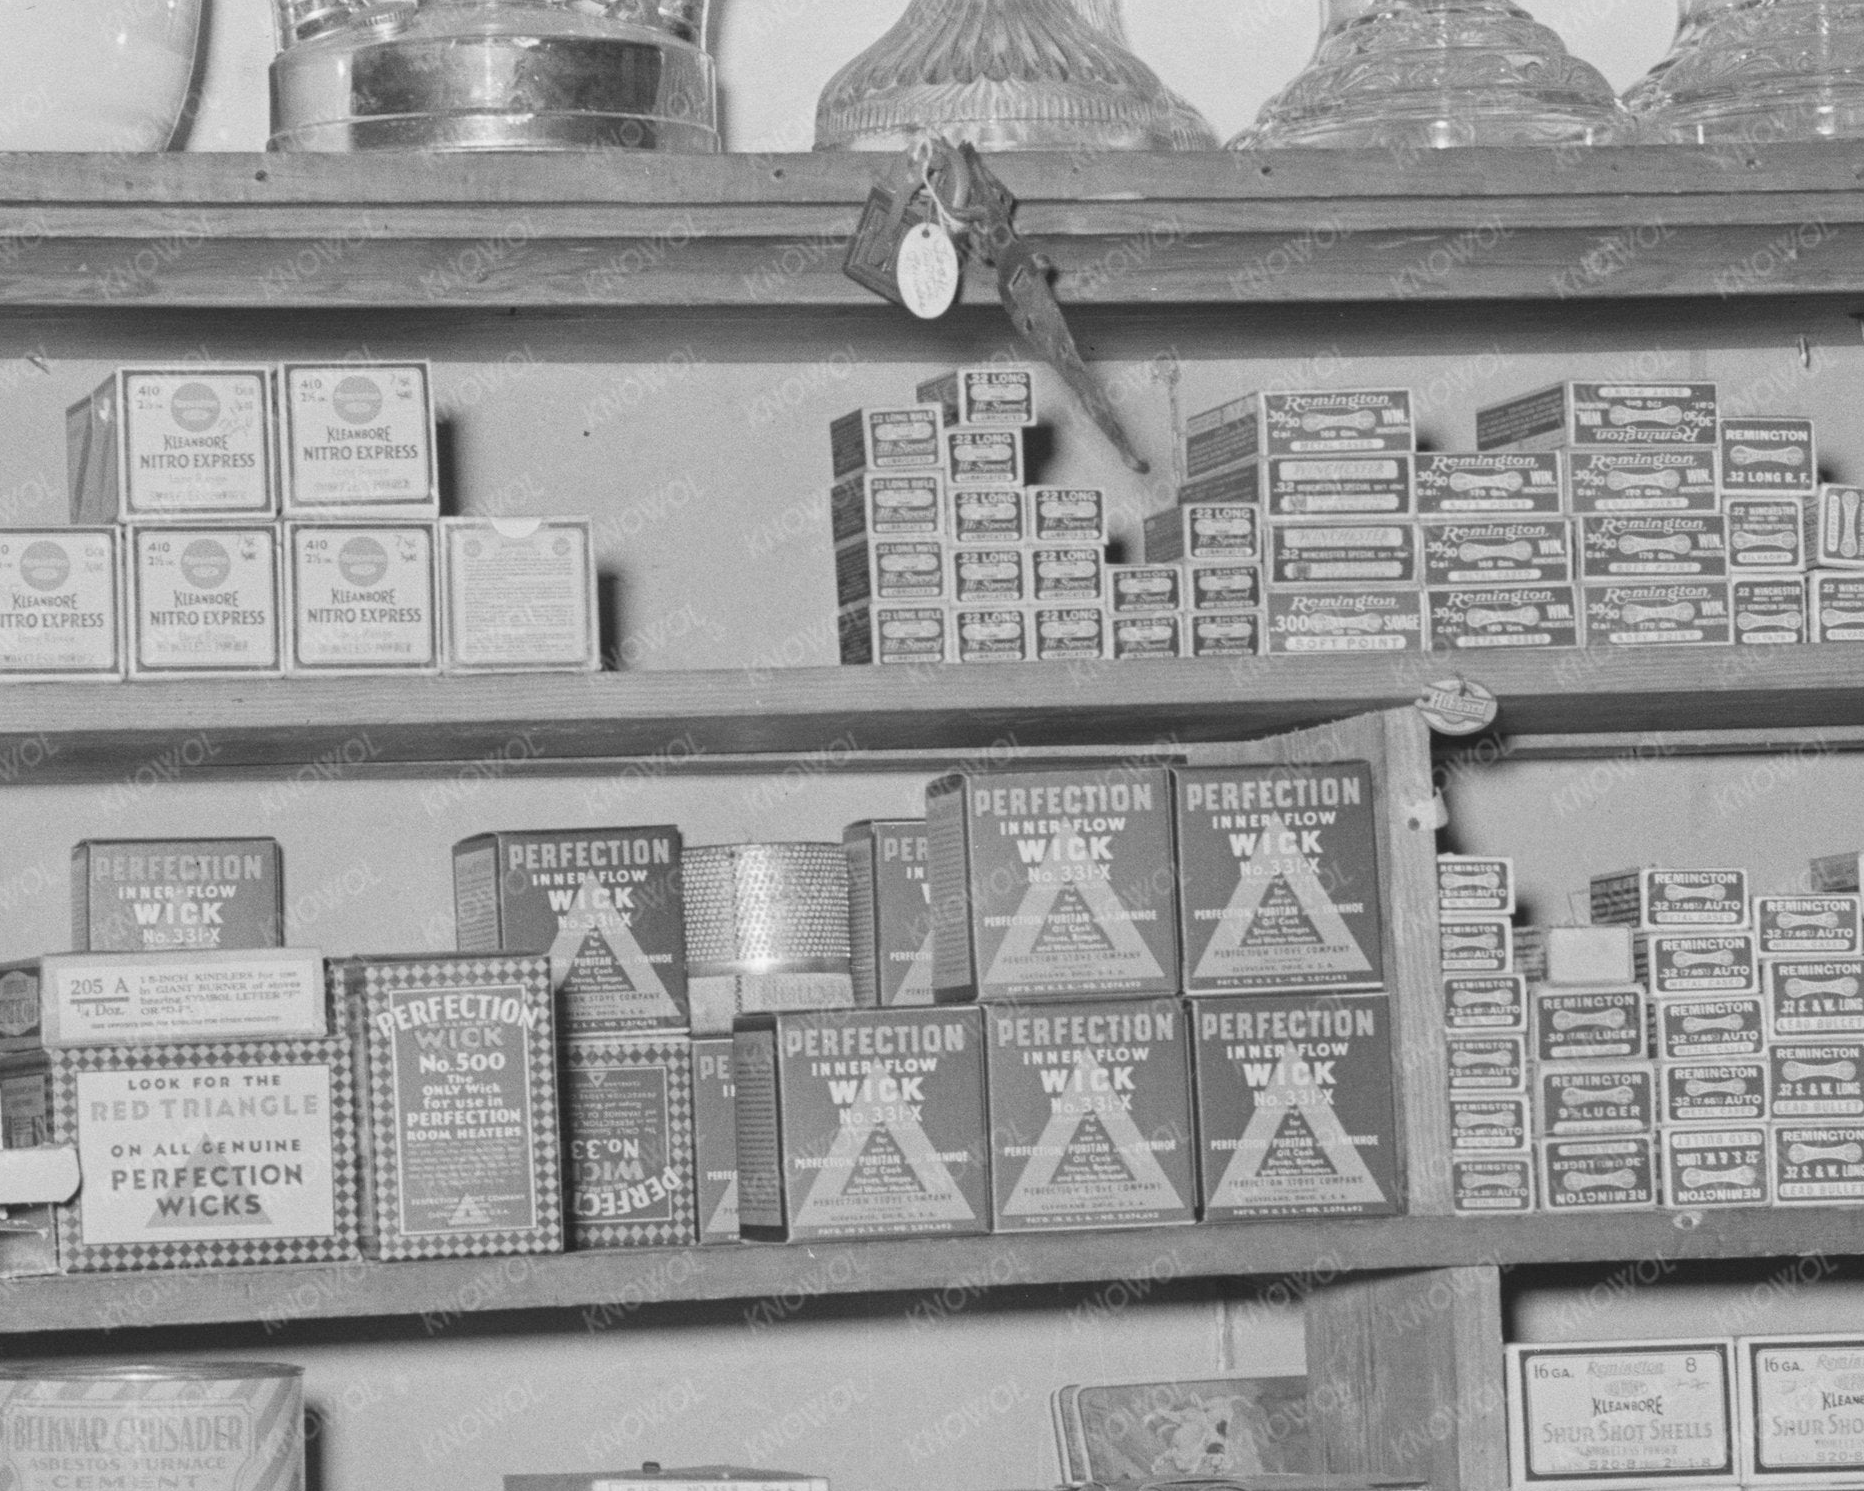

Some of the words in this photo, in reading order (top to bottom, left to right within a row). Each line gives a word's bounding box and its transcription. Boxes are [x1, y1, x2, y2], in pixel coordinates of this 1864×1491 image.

[988, 371, 1027, 385] LONG
[163, 434, 229, 451] KLEANBORE
[326, 425, 392, 443] KLEANBORE
[1725, 428, 1809, 442] REMINGTON
[140, 454, 190, 469] NITRO
[193, 453, 256, 468] EXPRESS
[303, 446, 352, 461] NITRO
[356, 444, 418, 460] EXPRESS
[1748, 471, 1781, 484] LONG
[974, 783, 1153, 817] PERFECTION
[1185, 778, 1361, 811] PERFECTION
[999, 817, 1126, 836] INNER-FLOW
[1016, 837, 1114, 864] WICK
[1227, 830, 1323, 855] WICK
[508, 838, 671, 870] PERFECTION
[94, 852, 262, 882] PERFECTION
[532, 869, 648, 887] INNER-FLOW
[1654, 873, 1737, 885] REMINGTON
[117, 884, 237, 900] INNER-FLOW
[547, 886, 636, 911] WICK
[135, 902, 224, 925] WICK
[1543, 995, 1635, 1009] REMINGTON
[376, 994, 540, 1037] PERFECTION
[1201, 1009, 1375, 1042] PERFECTION
[414, 1027, 504, 1049] WICK
[785, 1023, 965, 1056] PERFECTION
[997, 1013, 1174, 1046] PERFECTION
[1596, 1030, 1637, 1042] LUGER
[127, 1077, 181, 1091] LOOK
[189, 1076, 232, 1089] FOR
[244, 1073, 282, 1088] THE
[1040, 1068, 1135, 1093] WICK
[1241, 1061, 1337, 1087] WICK
[827, 1077, 926, 1104] WICK
[90, 1099, 149, 1122] RED
[161, 1094, 319, 1120] TRIANGLE
[406, 1109, 521, 1127] PERFECTION
[406, 1130, 452, 1141] ROOM
[457, 1126, 521, 1139] HEATERS
[110, 1143, 142, 1157] ON
[152, 1143, 192, 1156] ALL
[201, 1138, 303, 1155] GENUINE
[111, 1164, 304, 1191] PERFECTION
[156, 1193, 263, 1218] WICKS
[1591, 1395, 1664, 1417] KLEANBORE
[11, 1414, 104, 1453] BELKNAP
[106, 1415, 244, 1455] CRUSADER
[1542, 1422, 1598, 1444] SHUR
[1601, 1422, 1648, 1442] SHOT
[1651, 1420, 1714, 1441] SHELLS
[26, 1456, 123, 1471] ASBESTOS
[132, 1455, 227, 1471] FURNACE
[50, 1474, 202, 1489] CEMENT
